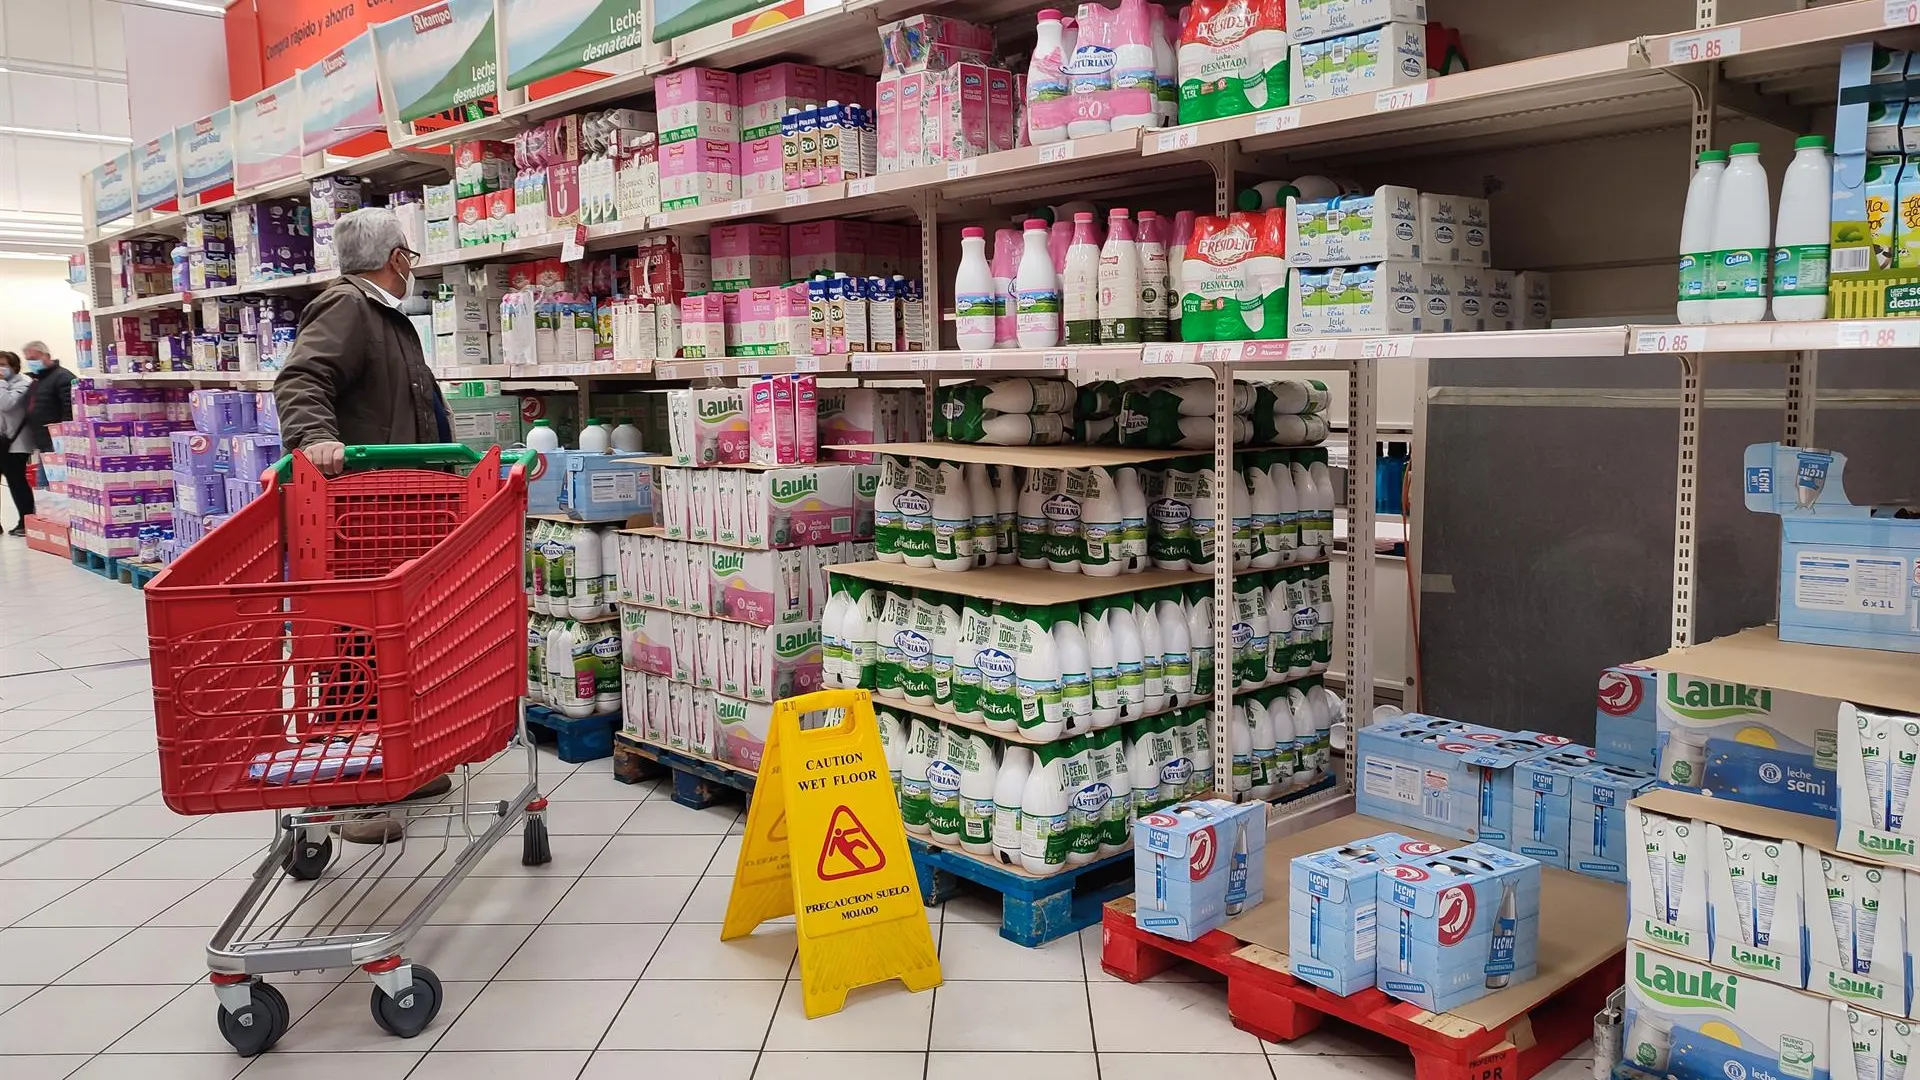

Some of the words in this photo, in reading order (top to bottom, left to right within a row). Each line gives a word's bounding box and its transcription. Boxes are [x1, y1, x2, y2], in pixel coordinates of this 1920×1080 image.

[609, 9, 642, 35] Leche
[265, 37, 290, 60] Compra
[317, 17, 323, 36] y
[325, 4, 354, 27] ahorra
[582, 26, 641, 63] desnatada
[1689, 39, 1721, 60] 0.85
[472, 60, 495, 82] Leche
[1201, 57, 1248, 74] DESNATADA
[453, 77, 495, 105] desnatada
[1389, 92, 1413, 109] 0.71
[799, 117, 817, 128] PULEVA
[820, 114, 838, 124] PULEVA
[1327, 245, 1344, 257] Leche
[1725, 252, 1751, 265] Celta
[1200, 280, 1245, 291] DESNATADA
[1328, 317, 1345, 331] Leche
[1657, 335, 1689, 351] 0.85
[1860, 329, 1895, 347] 0.88
[1376, 343, 1399, 357] 0.71
[698, 395, 743, 417] Lauki
[816, 395, 846, 412] auki
[1759, 469, 1769, 493] LECHE
[1800, 467, 1825, 478] LECHE
[771, 475, 818, 497] Lauki
[712, 551, 744, 570] Lauki
[783, 610, 803, 620] Lauki
[776, 626, 822, 652] Lauki
[999, 630, 1017, 643] 100%
[1667, 672, 1771, 712] Lauki
[715, 698, 748, 719] Lauki
[805, 751, 864, 771] CAUTION
[1070, 763, 1088, 776] CERO
[797, 776, 827, 792] WET
[833, 769, 878, 787] FLOOR
[1533, 774, 1553, 785] LECHE
[1786, 767, 1812, 780] leche
[1593, 787, 1614, 799] LECHE
[1787, 778, 1826, 797] semi
[1150, 830, 1169, 842] LECHE
[1858, 829, 1915, 856] Lauki
[1230, 867, 1247, 880] LECHE
[1309, 872, 1329, 886] LECHE
[804, 892, 874, 914] PRECAUCION
[876, 884, 910, 900] SUELO
[1394, 883, 1416, 899] LECHE
[1445, 891, 1462, 900] Auchan
[841, 905, 879, 921] MOJADO
[1645, 920, 1690, 946] Lauki
[1757, 932, 1769, 943] PLS
[1493, 936, 1513, 949] LECHE
[1731, 945, 1781, 971] Lauki
[1857, 960, 1870, 970] PLS
[1635, 952, 1738, 1010] Lauki
[1829, 971, 1884, 1000] Lauki
[1782, 1036, 1804, 1046] NUEVO
